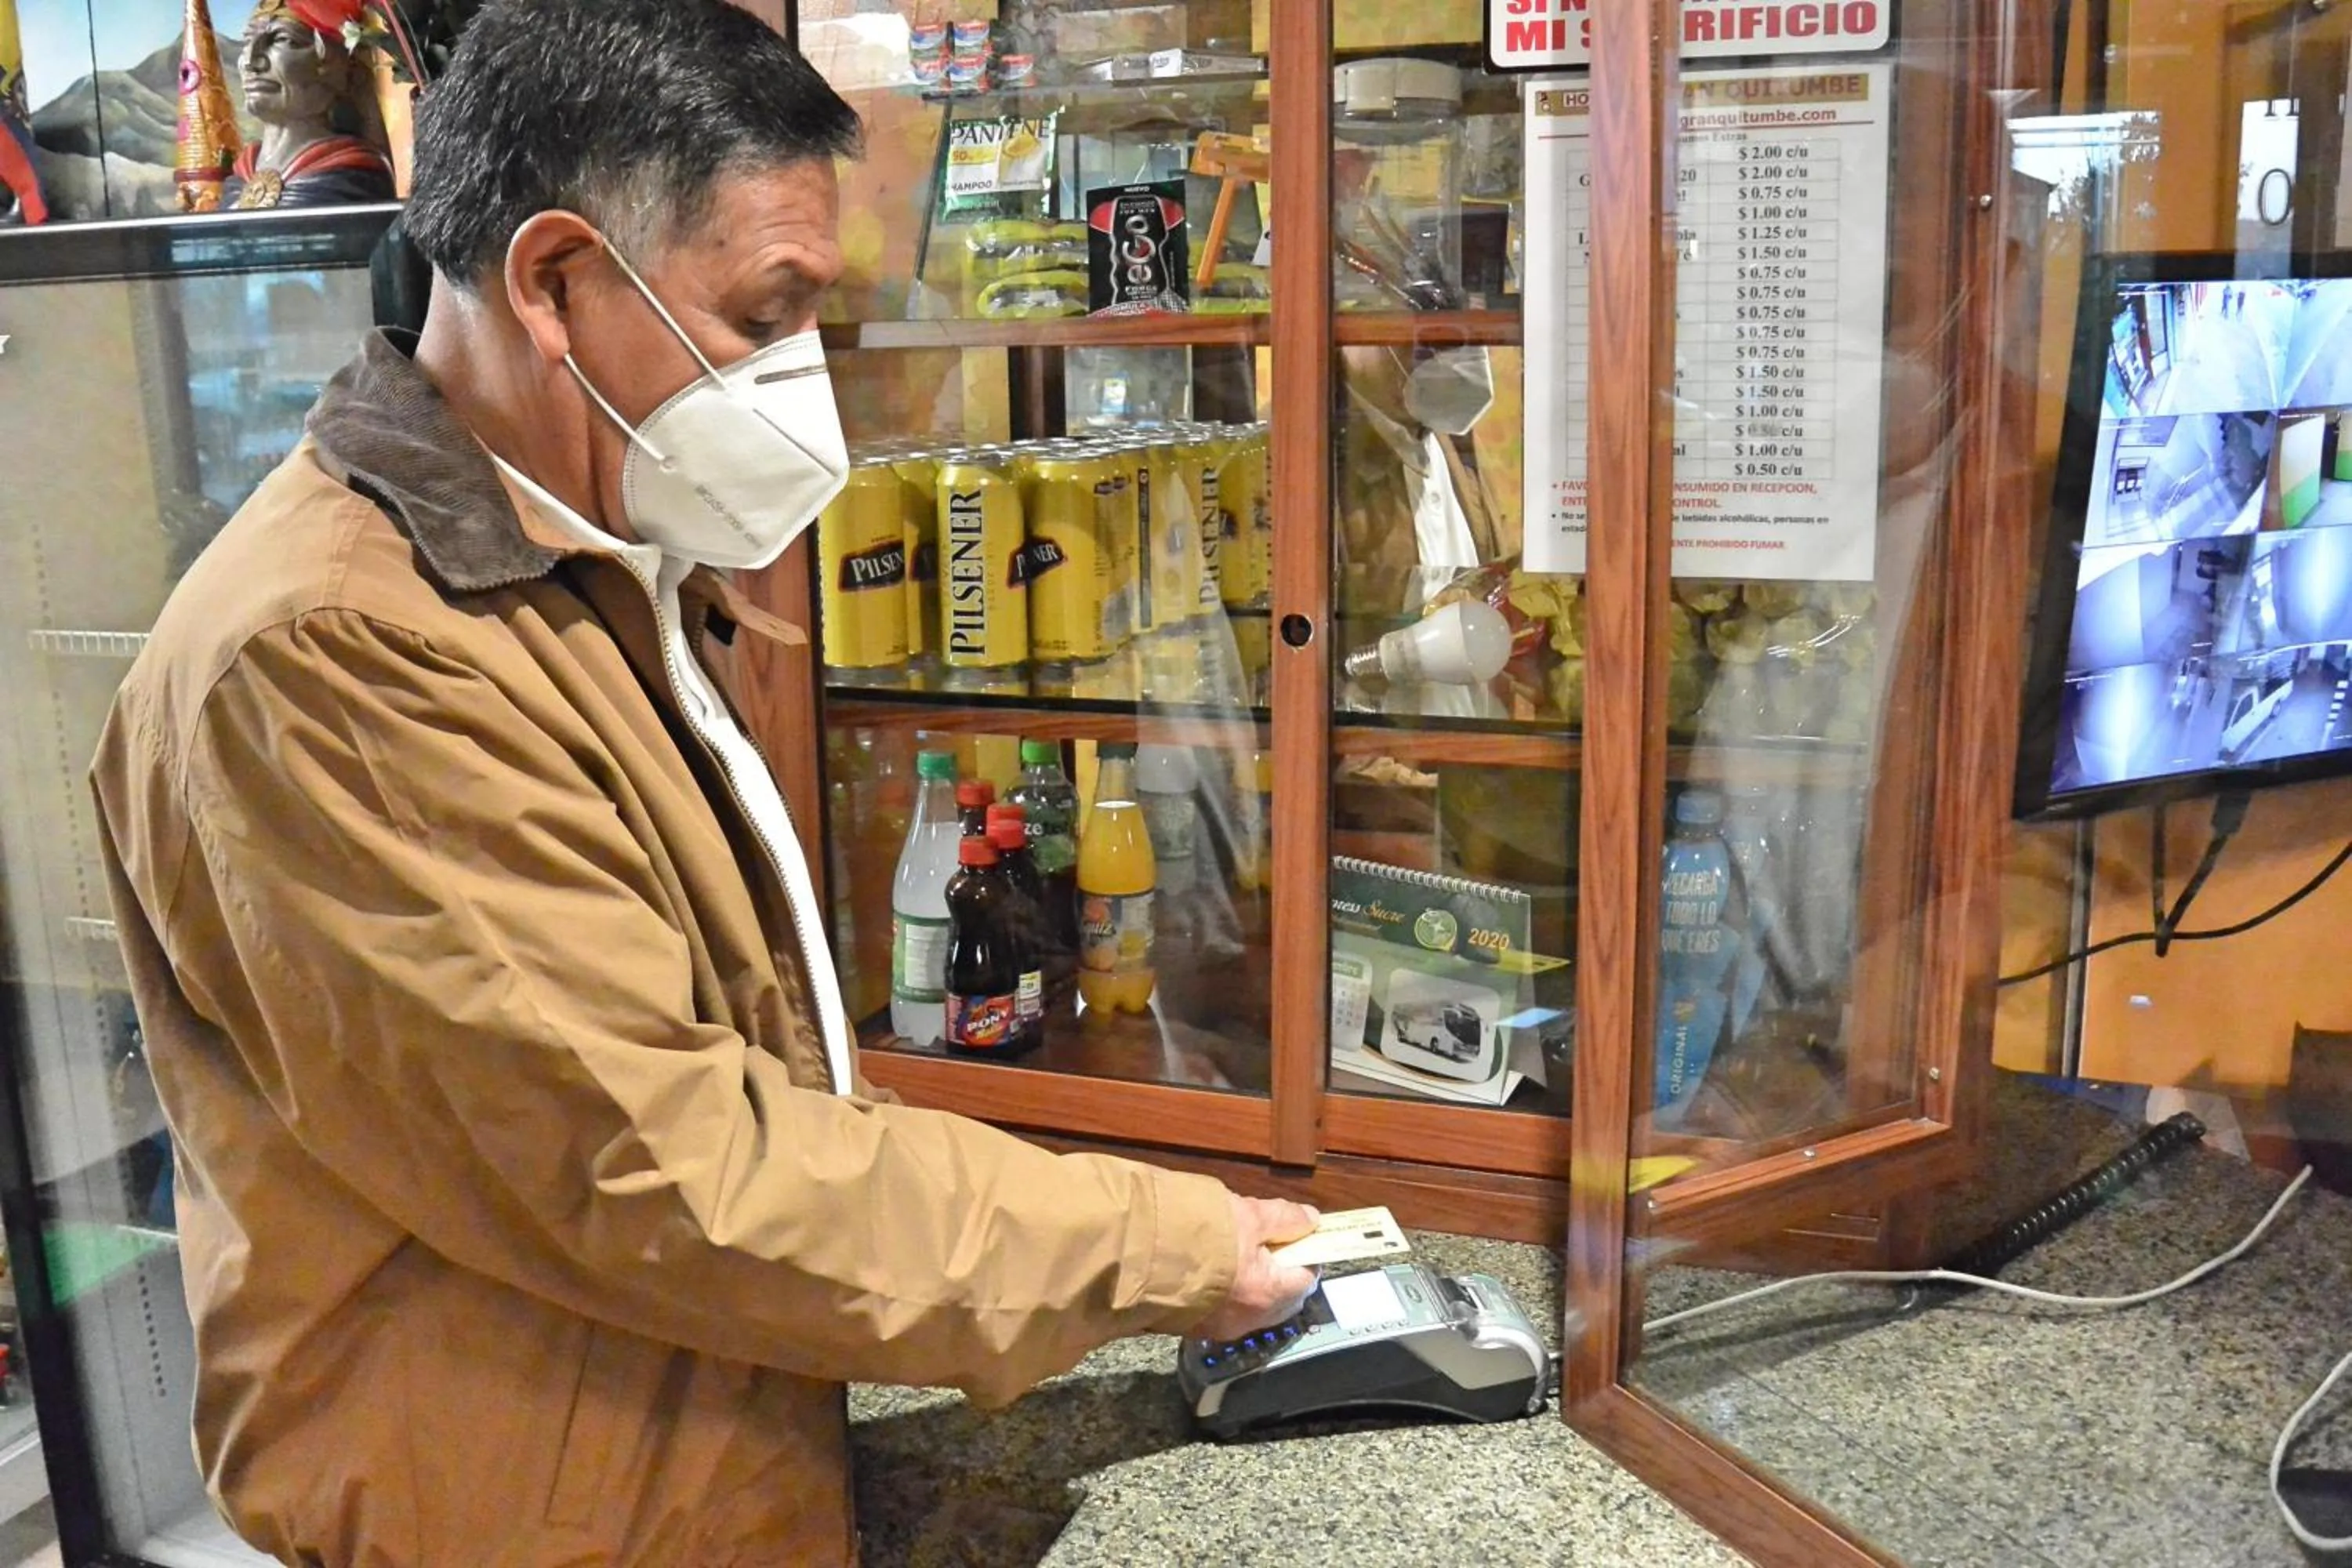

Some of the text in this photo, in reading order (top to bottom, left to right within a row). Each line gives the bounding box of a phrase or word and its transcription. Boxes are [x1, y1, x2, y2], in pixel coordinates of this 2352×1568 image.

[1506, 19, 1565, 52] MI
[1739, 144, 1808, 160] $ 2.00 c/u
[1739, 167, 1748, 180] $
[1751, 166, 1781, 180] 2.00
[1786, 165, 1808, 179] c/u
[1738, 185, 1807, 200] $ 0.75 c/u
[1738, 205, 1807, 220] $ 1.00 c/u
[1737, 226, 1807, 240] $ 1.25 c/u
[1737, 247, 1746, 260] $
[1751, 246, 1780, 259] 1.50
[1784, 245, 1806, 258] c/u
[1737, 266, 1806, 280] $ 0.75 c/u
[1737, 285, 1806, 299] $ 0.75 c/u
[1737, 305, 1806, 319] $ 0.75 c/u
[1736, 325, 1806, 339] $ 0.75 c/u
[1736, 345, 1805, 358] $ 0.75 c/u
[1735, 365, 1805, 378] $ 1.50 c/u
[1735, 384, 1804, 397] $ 1.50 c/u
[1735, 404, 1804, 417] $ 1.00 c/u
[1735, 424, 1744, 437] $
[1781, 423, 1803, 437] c/u
[1735, 443, 1803, 456] $ 1.00 c/u
[1734, 463, 1802, 476] $ 0.50 c/u
[1674, 483, 1730, 493] NSUMIDO
[1733, 483, 1748, 492] EN
[1673, 497, 1722, 508] ONTROL.
[949, 488, 986, 655] PILSENER
[1468, 927, 1511, 951] 2020
